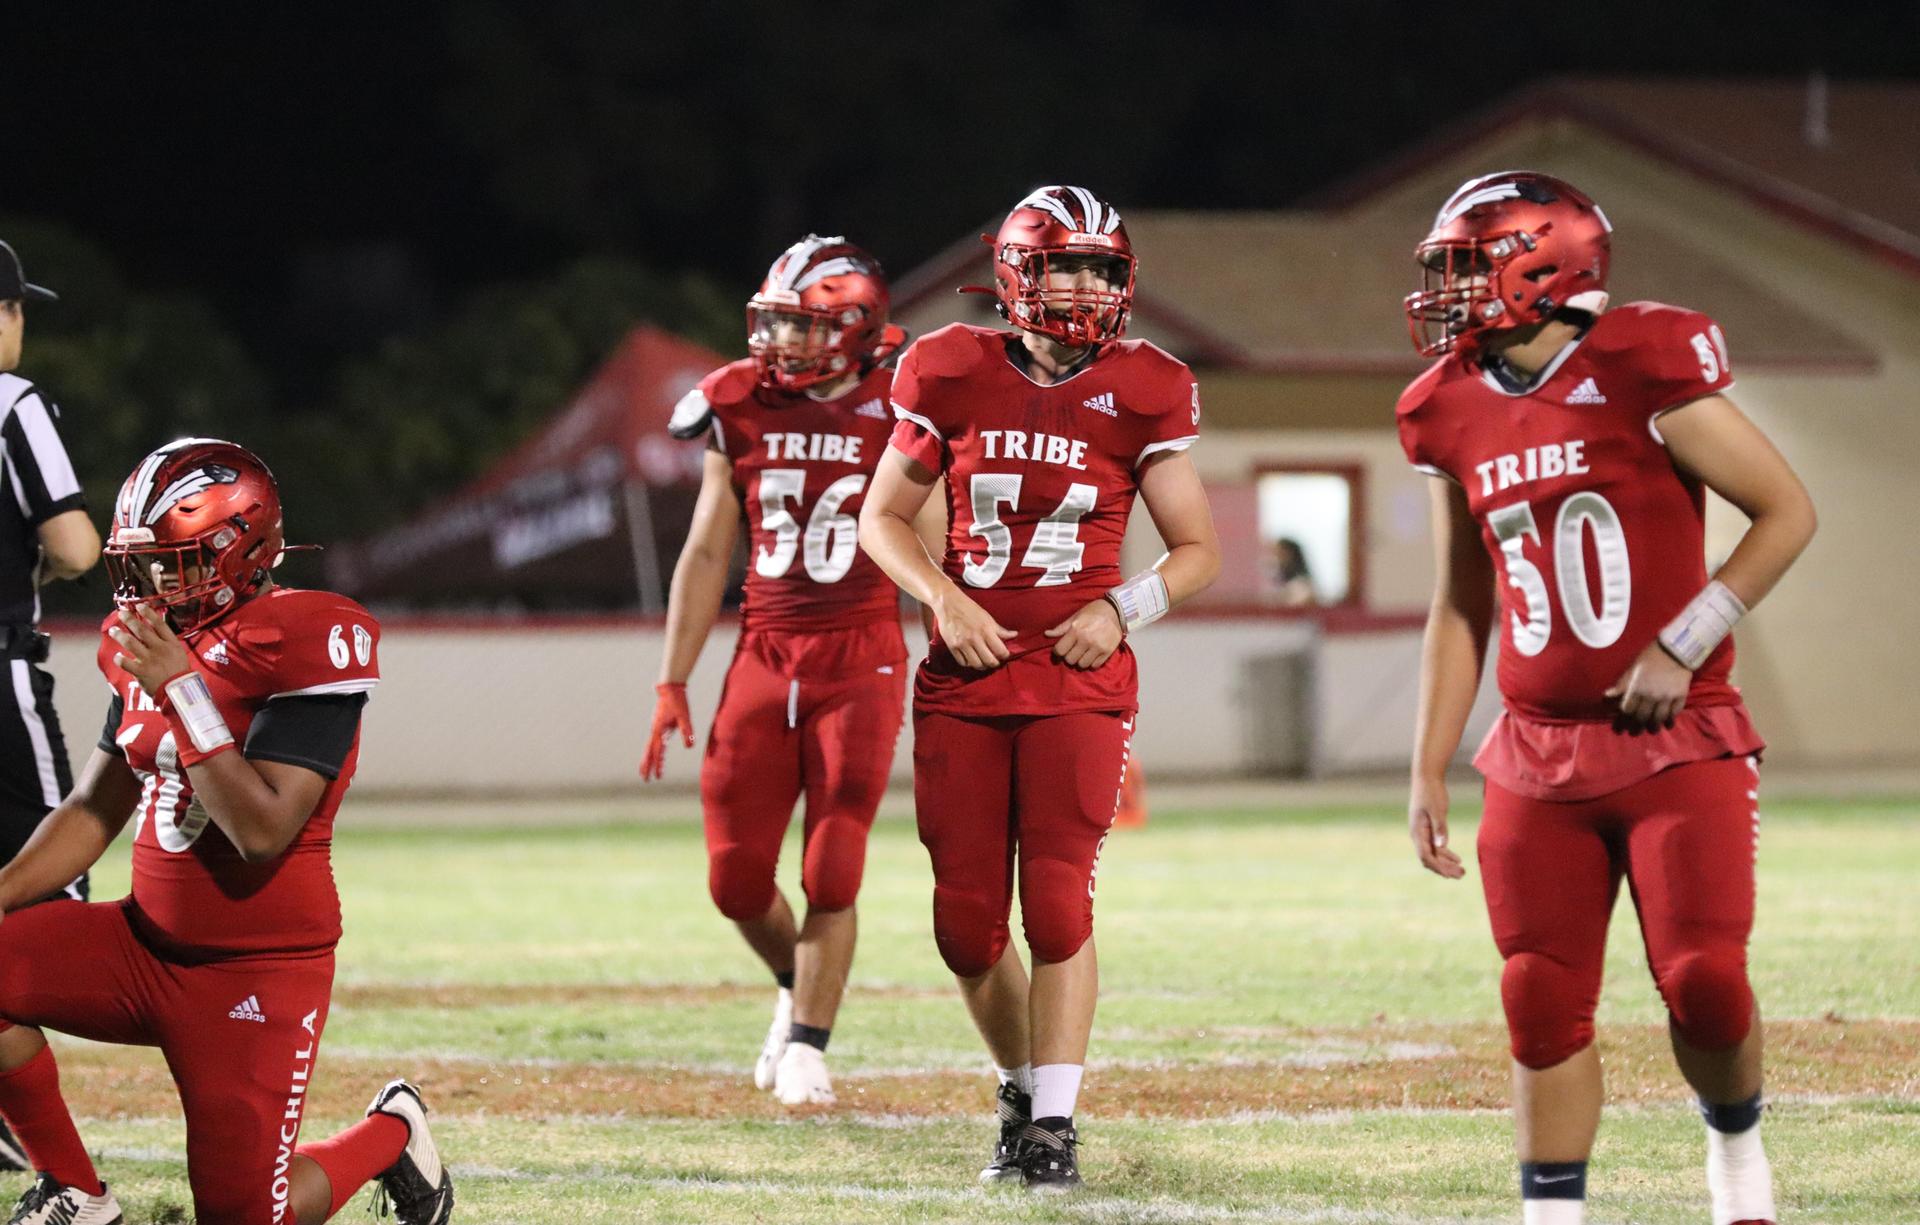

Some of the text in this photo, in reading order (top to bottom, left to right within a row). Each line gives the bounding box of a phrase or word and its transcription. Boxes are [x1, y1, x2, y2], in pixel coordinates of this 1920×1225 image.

[1083, 399, 1118, 418] adidas
[1566, 394, 1607, 405] adidas
[762, 432, 864, 465] TRIBE
[980, 430, 1089, 471] TRIBE
[1475, 440, 1591, 497] TRIBE
[756, 469, 868, 584] 56
[962, 473, 1099, 589] 54
[1486, 491, 1632, 657] 50
[328, 624, 371, 670] 60
[228, 1008, 266, 1024] adidas
